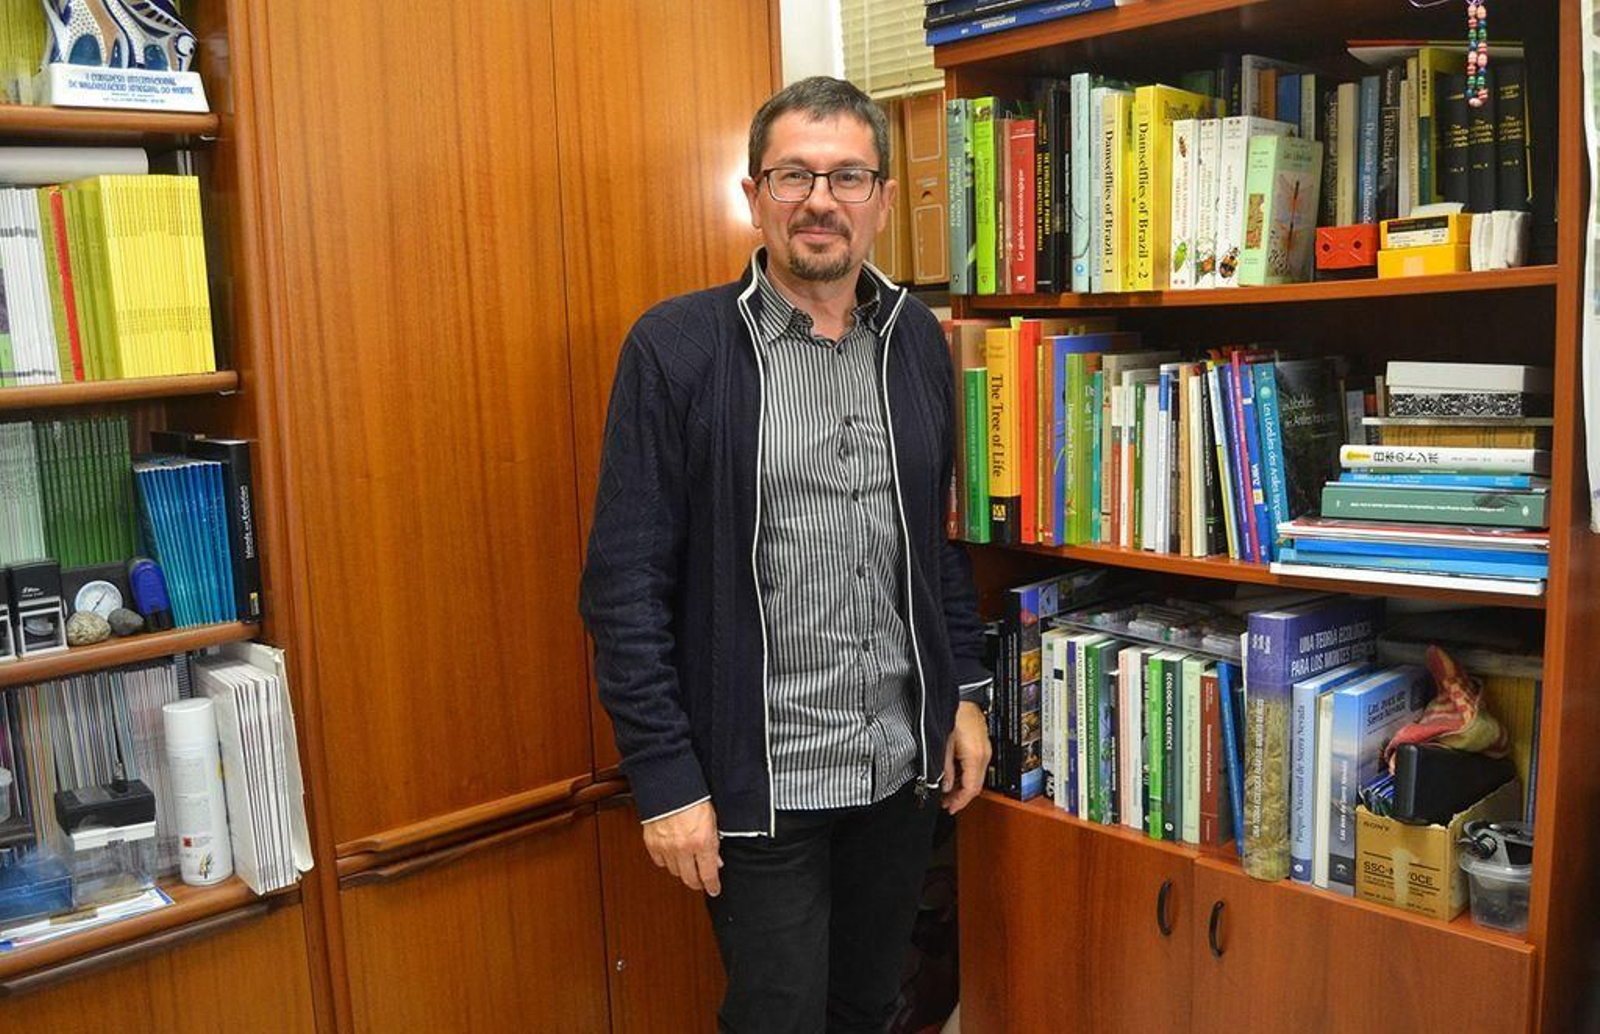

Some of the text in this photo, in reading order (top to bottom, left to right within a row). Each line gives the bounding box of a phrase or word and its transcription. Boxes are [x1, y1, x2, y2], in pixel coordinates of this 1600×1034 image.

[1104, 130, 1114, 201] Damselflies
[1139, 123, 1149, 199] Damselflies
[1104, 203, 1114, 216] of
[1139, 201, 1149, 215] of
[1103, 219, 1114, 256] Brazil
[1139, 219, 1149, 258] Brazil
[1138, 271, 1148, 279] 2
[991, 375, 1004, 477] The Tree of Life
[1299, 634, 1314, 654] UNA
[1291, 658, 1310, 677] PARA
[1310, 653, 1324, 672] LOS
[1165, 672, 1173, 715] ECOLOGICAL
[1297, 705, 1305, 736] Nevada
[1363, 820, 1389, 832] SONY
